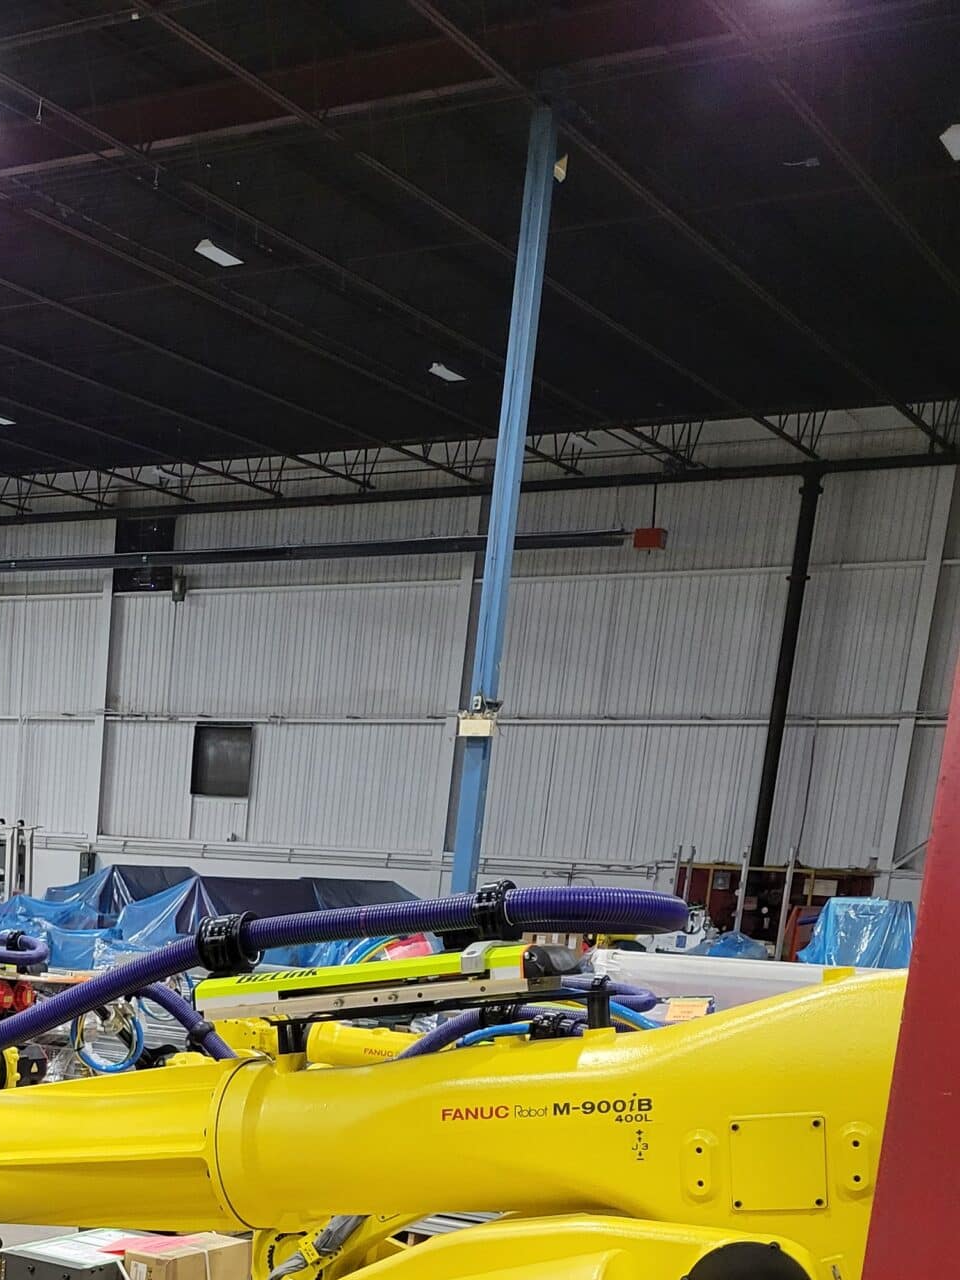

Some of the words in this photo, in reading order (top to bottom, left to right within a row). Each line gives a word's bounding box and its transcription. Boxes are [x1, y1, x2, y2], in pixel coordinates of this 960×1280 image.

[363, 1047, 394, 1058] FANUC
[441, 1105, 509, 1121] FANUC
[514, 1104, 548, 1118] Robot
[552, 1092, 653, 1116] M-900iB
[614, 1113, 653, 1123] 400L
